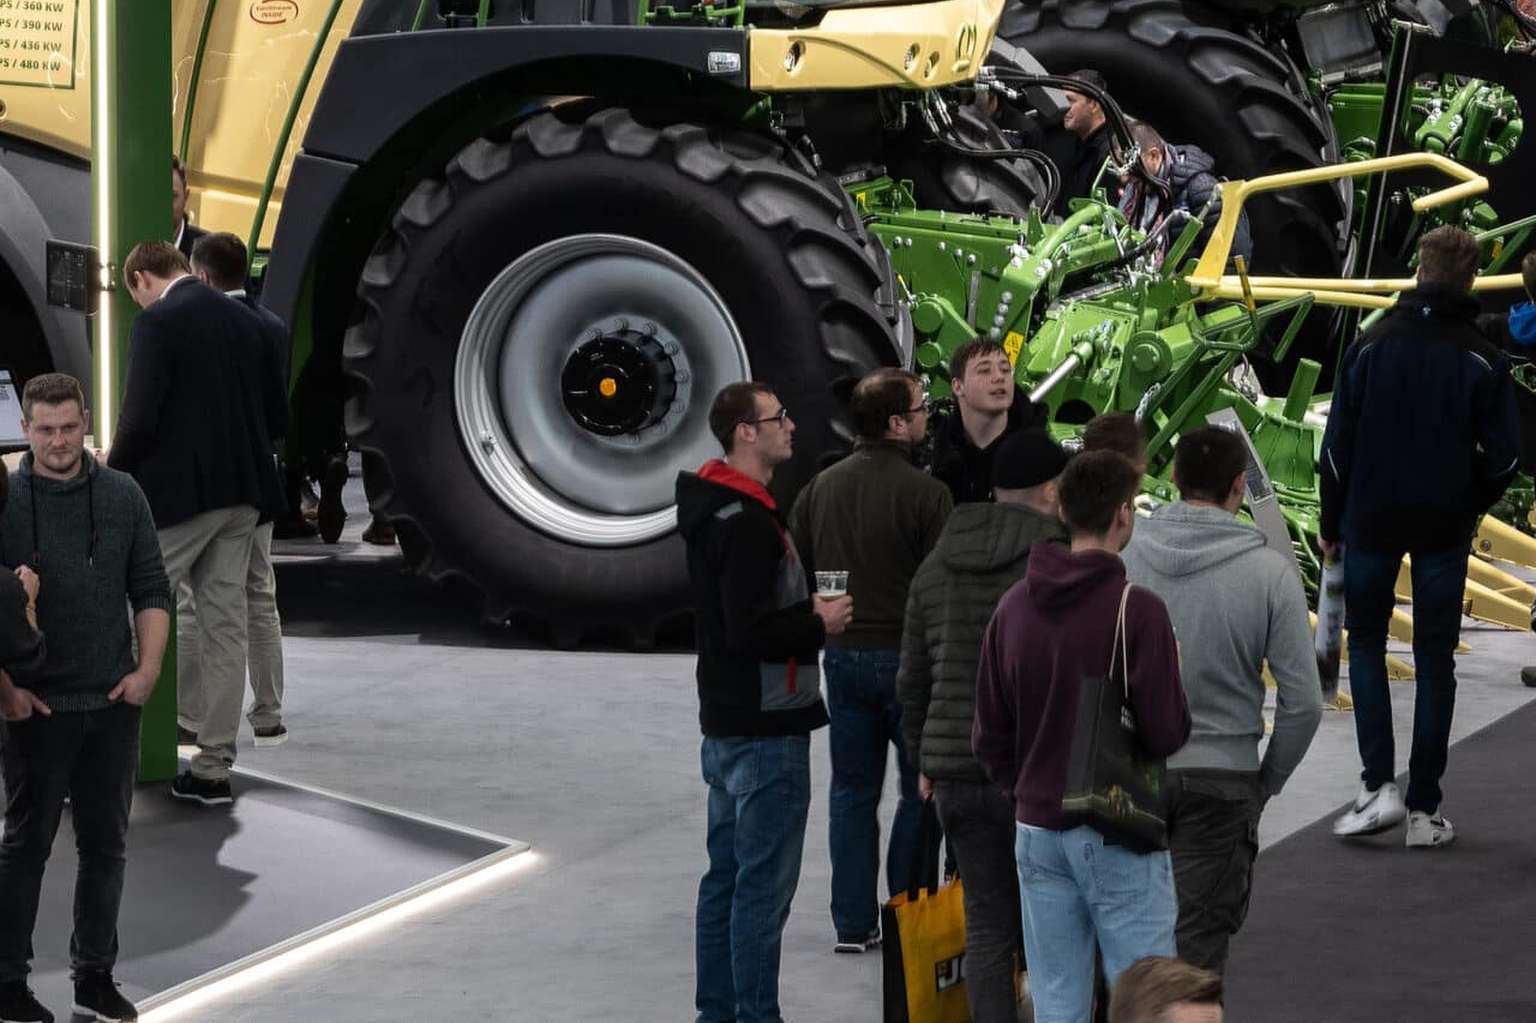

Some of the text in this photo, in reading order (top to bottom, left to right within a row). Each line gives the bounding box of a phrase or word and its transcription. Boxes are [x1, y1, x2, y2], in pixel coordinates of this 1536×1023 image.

[23, 1, 42, 11] 360
[45, 2, 64, 12] KW
[22, 20, 41, 31] 390
[44, 21, 63, 32] KW
[20, 41, 40, 51] 436
[43, 42, 62, 52] KW
[20, 59, 39, 70] 480
[42, 61, 61, 72] KW
